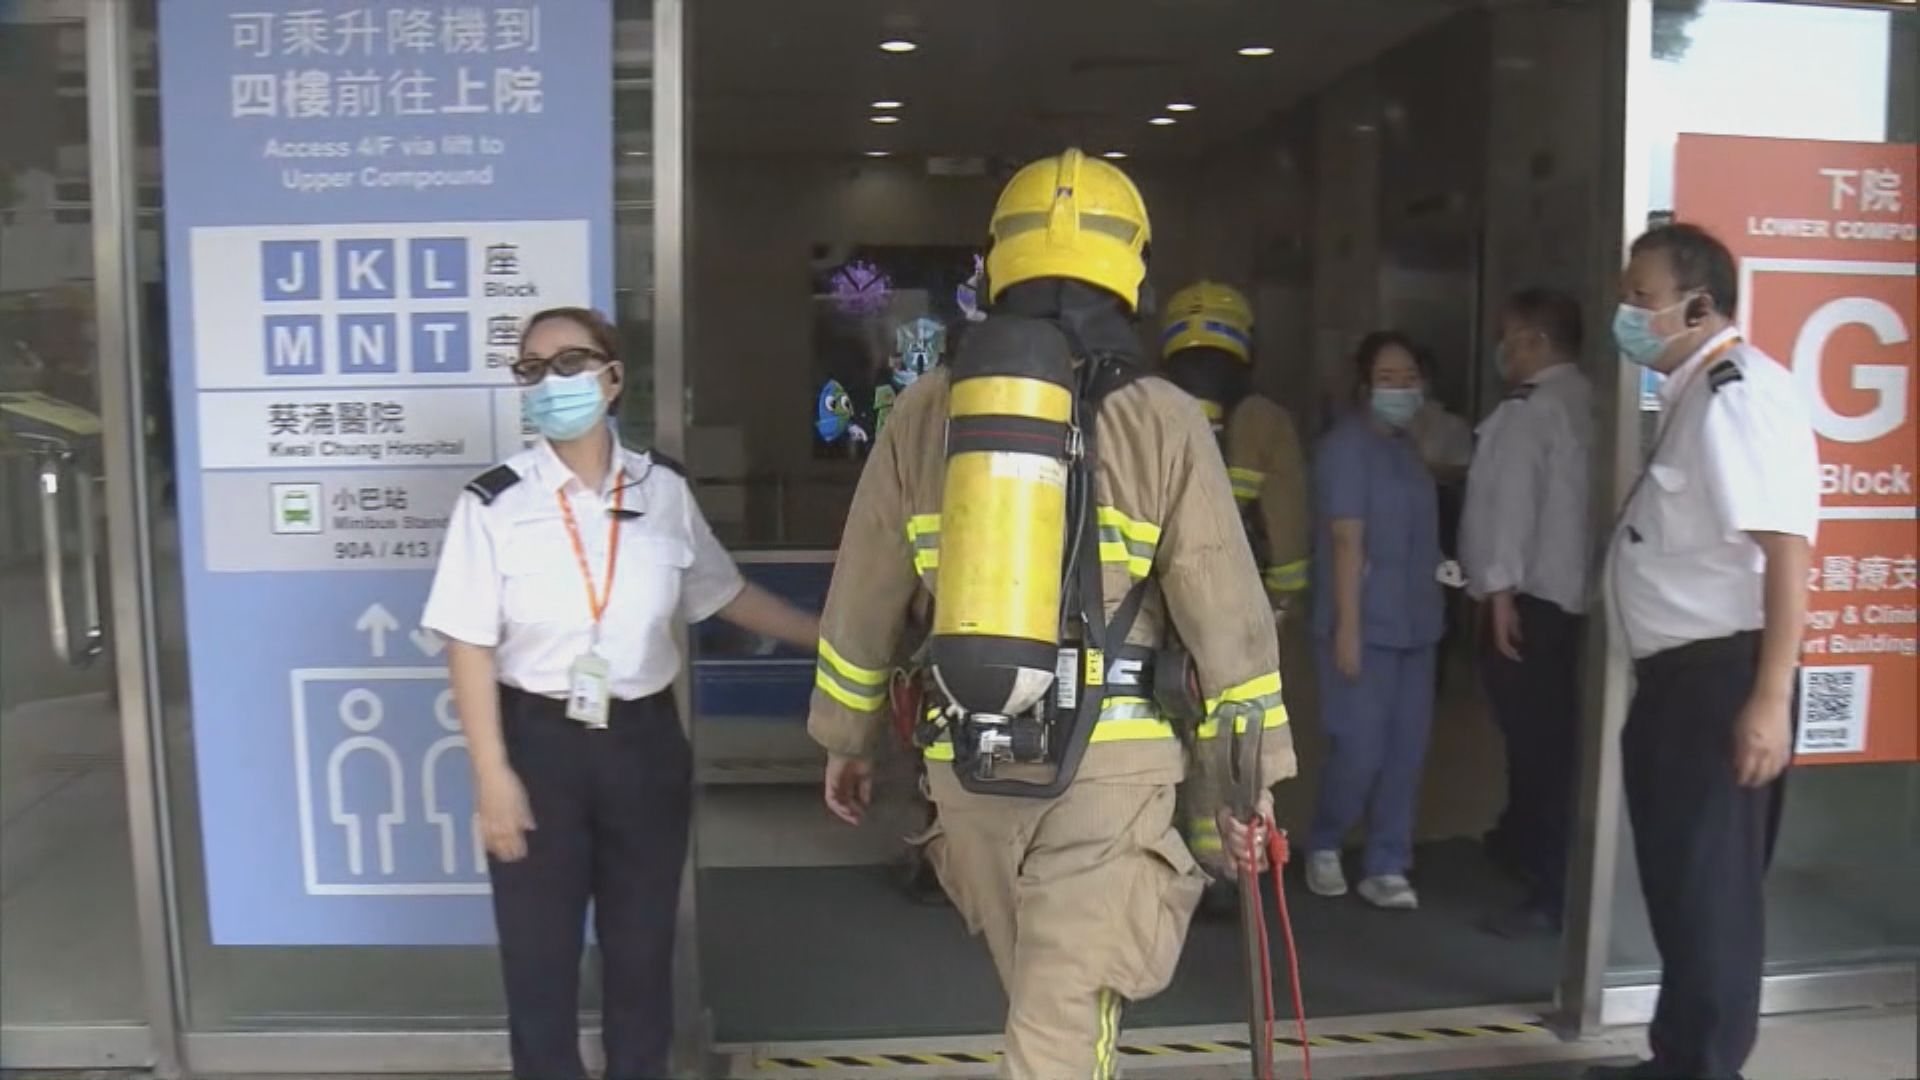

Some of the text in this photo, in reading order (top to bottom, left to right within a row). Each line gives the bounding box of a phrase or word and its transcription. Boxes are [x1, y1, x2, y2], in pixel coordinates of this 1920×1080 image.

[229, 6, 541, 57] 可乘升降機到
[231, 66, 543, 118] 四樓前往上院
[264, 135, 504, 157] Access 4/F via lift to
[282, 164, 494, 192] Upper Compound
[1819, 168, 1902, 212] 下院
[1747, 216, 1830, 238] LOWER
[276, 242, 520, 293] J K L 座
[485, 281, 539, 298] Block
[273, 313, 520, 367] M N T 座
[1791, 297, 1909, 443] G
[267, 401, 405, 436] 葵涌醫院
[269, 438, 466, 460] Kwai Chung Hospital
[1818, 464, 1912, 495] Block
[332, 486, 408, 511] 小巴站
[332, 516, 398, 530] Minibus
[335, 542, 374, 559] 90A
[392, 541, 430, 558] 413
[1842, 604, 1859, 625] &
